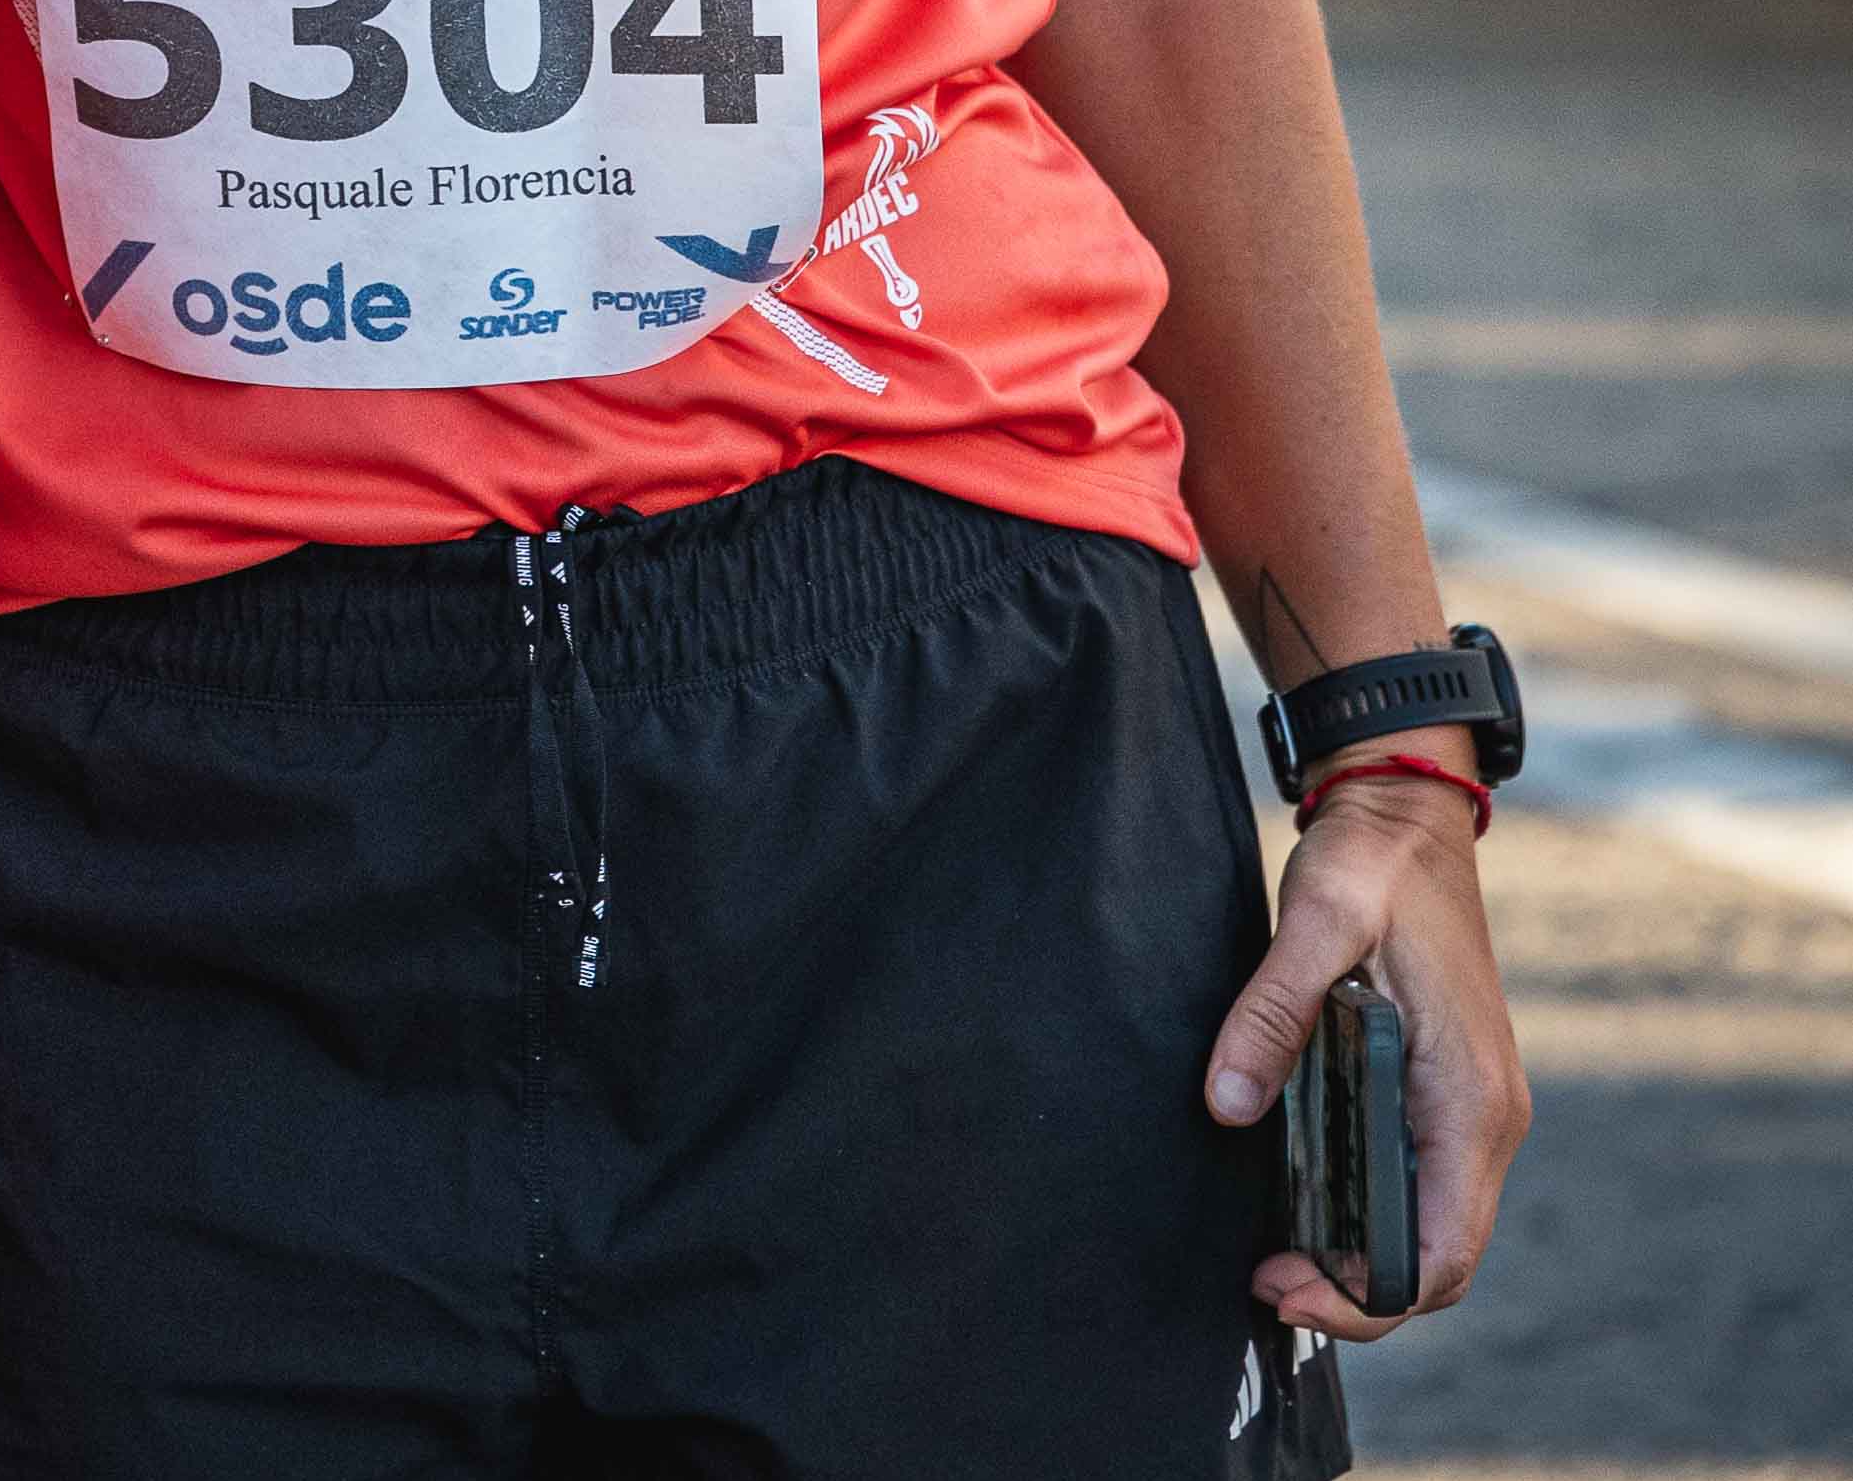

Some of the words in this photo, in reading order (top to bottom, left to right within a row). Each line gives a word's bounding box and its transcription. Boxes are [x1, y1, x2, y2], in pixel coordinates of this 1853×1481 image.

[218, 167, 412, 221] Pasquale
[427, 155, 636, 207] Florencia
[172, 262, 411, 348] osde
[592, 286, 708, 311] POWER
[515, 536, 534, 586] RUNNING
